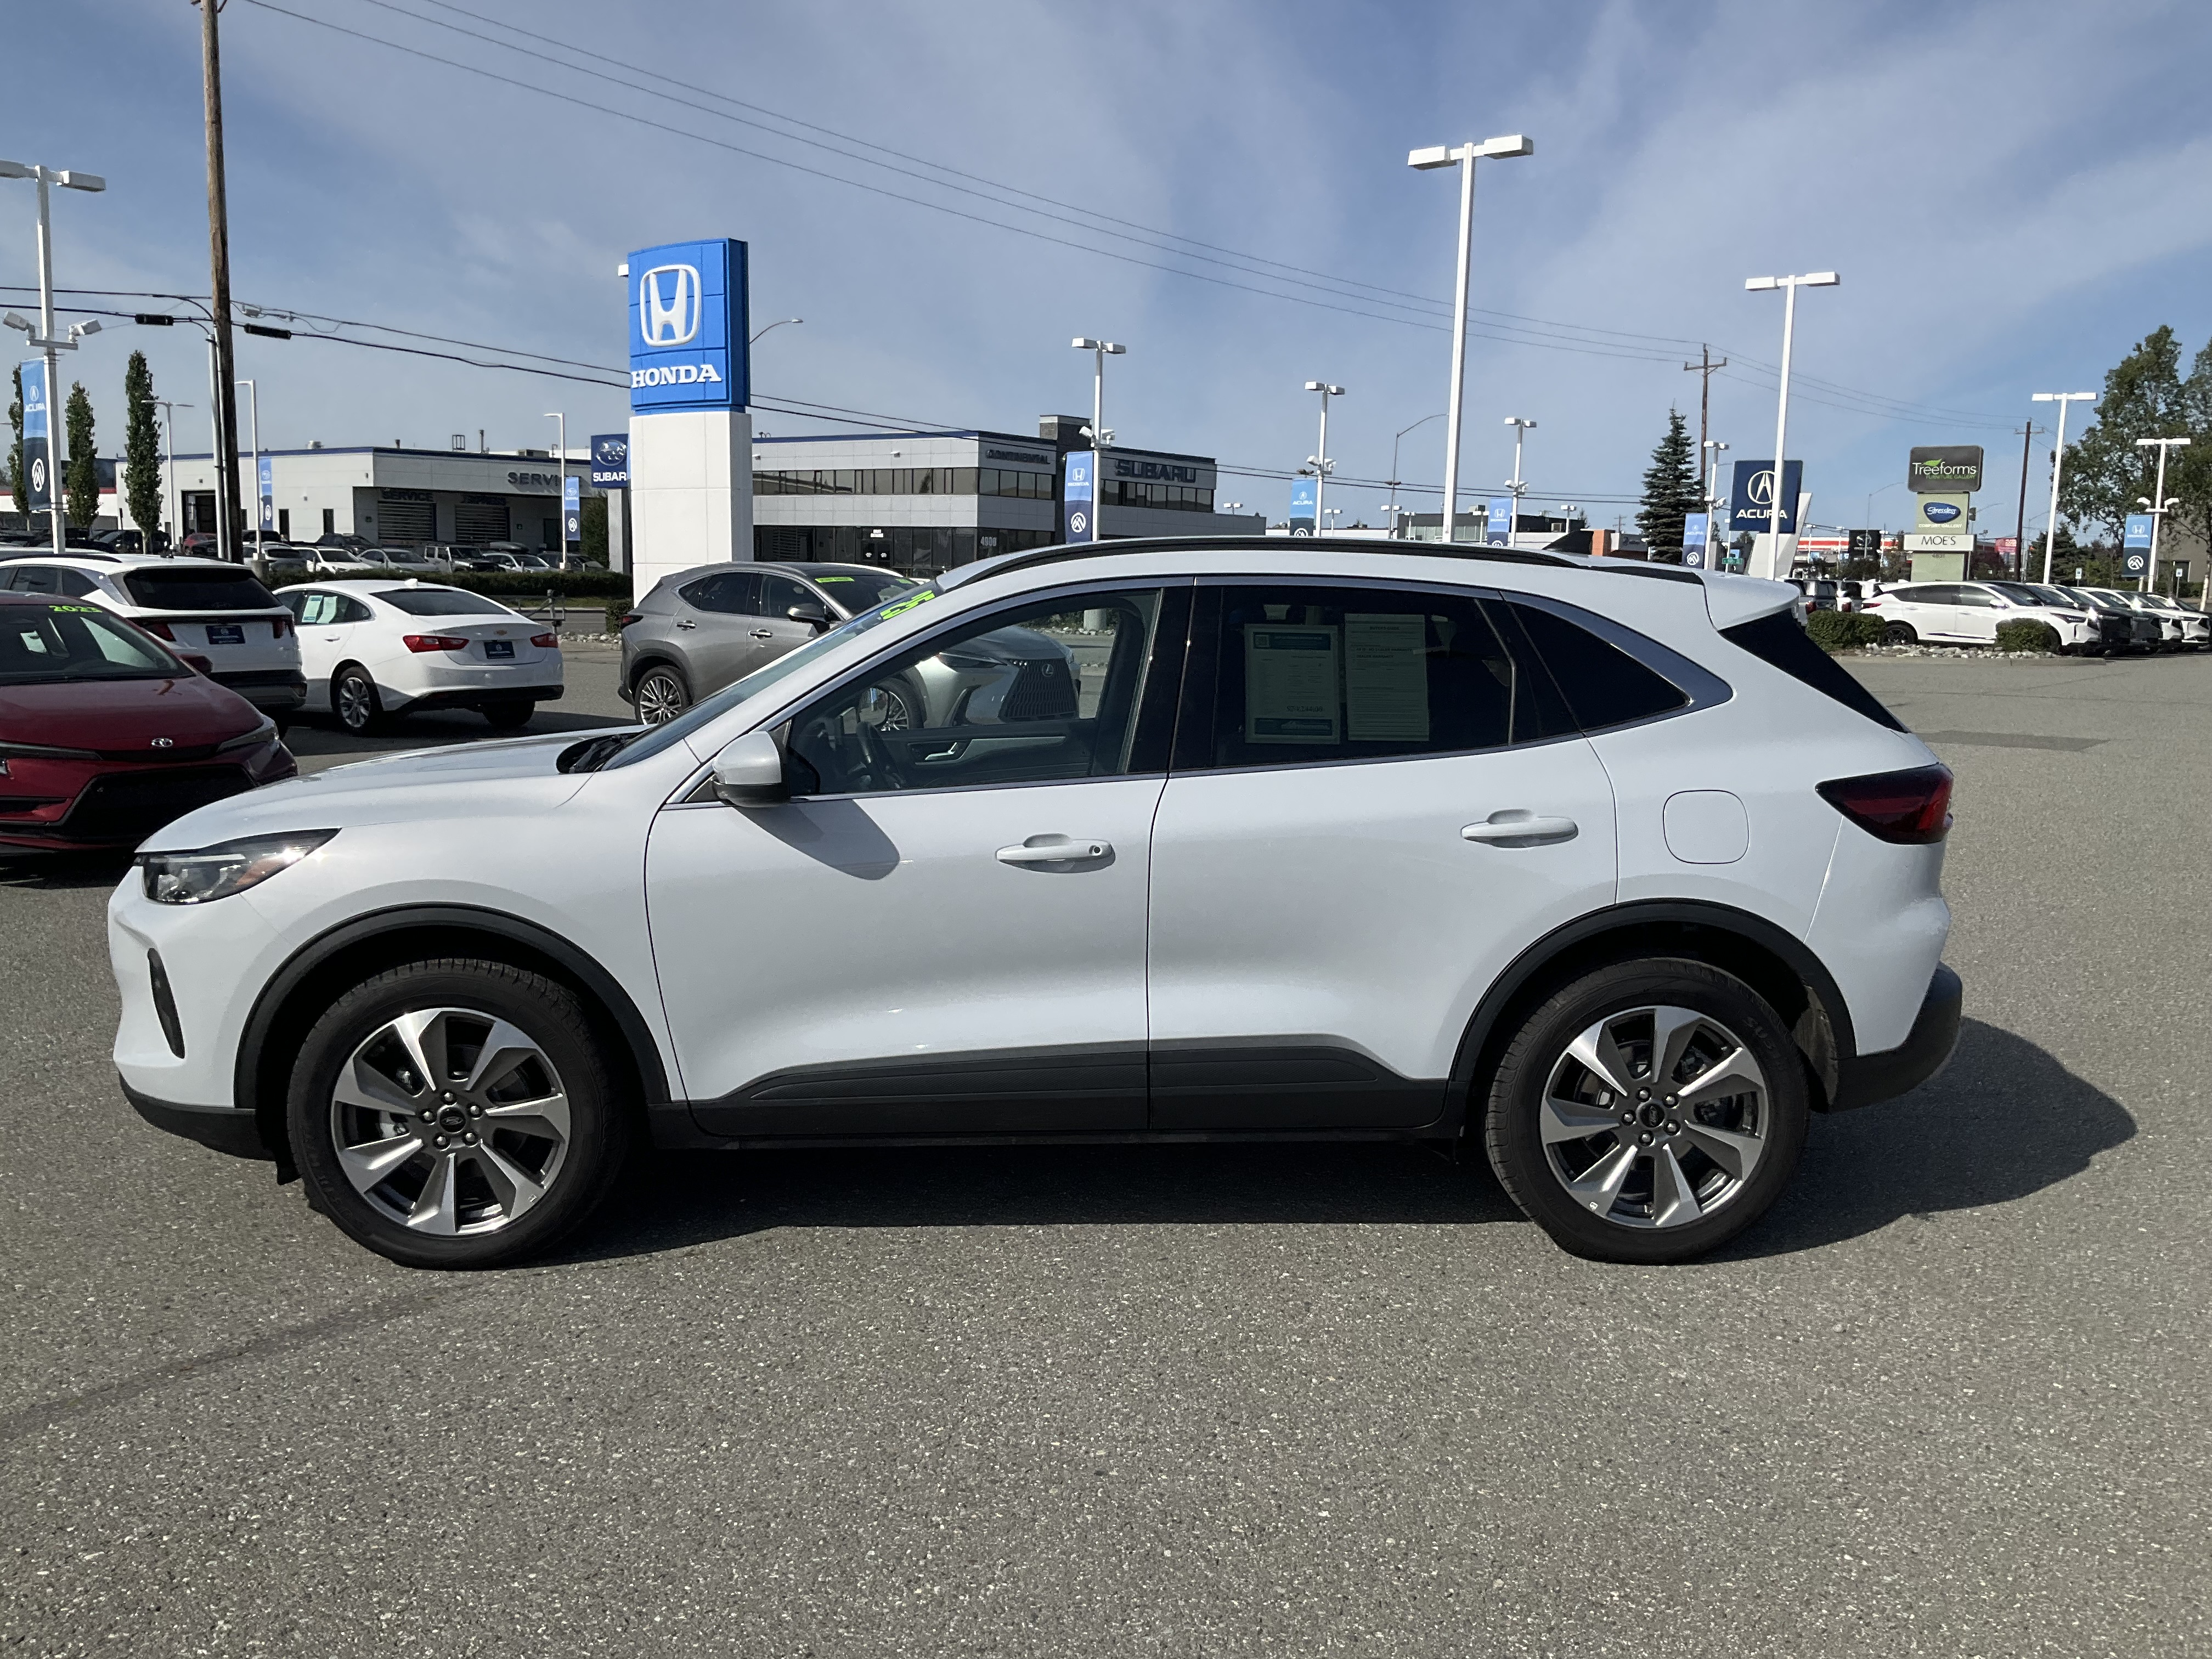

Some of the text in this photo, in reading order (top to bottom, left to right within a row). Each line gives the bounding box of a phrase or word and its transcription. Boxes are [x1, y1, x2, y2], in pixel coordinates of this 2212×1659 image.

[631, 364, 722, 388] HONDA
[25, 403, 46, 412] ACURA
[986, 449, 1051, 465] CONTINENTAL
[1115, 459, 1197, 483] SUBARU
[1912, 461, 1977, 475] Treeforms
[507, 472, 580, 487] SERVI
[592, 471, 627, 482] SUBAR
[1736, 509, 1788, 519] ACURA
[1927, 506, 1957, 515] Stressless
[1921, 535, 1956, 545] MOE'S
